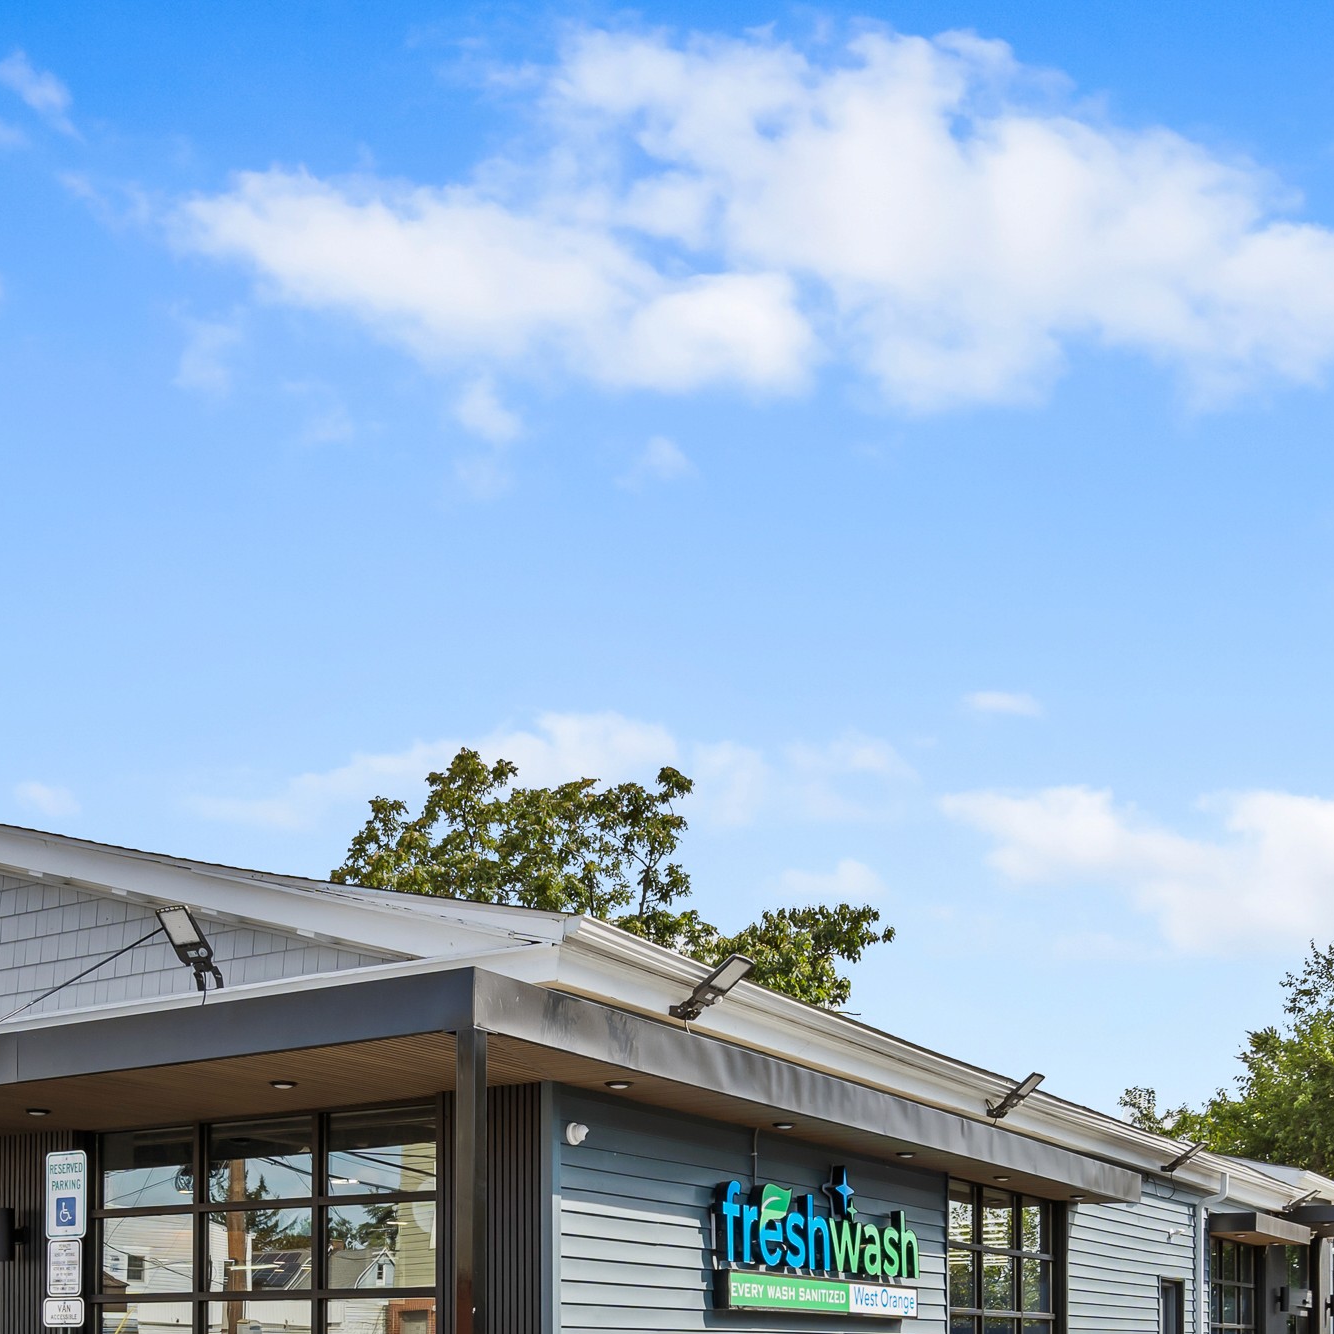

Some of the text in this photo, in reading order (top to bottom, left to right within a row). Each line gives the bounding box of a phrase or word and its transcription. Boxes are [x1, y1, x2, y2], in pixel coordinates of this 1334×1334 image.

[49, 1162, 83, 1175] RESERVED
[51, 1179, 81, 1191] PARKING
[722, 1180, 920, 1279] freshwash
[731, 1282, 846, 1304] EVERY WASH SANITIZED
[853, 1286, 915, 1314] West Orange
[57, 1304, 72, 1313] VAN
[50, 1313, 78, 1321] ACCESSIBLE
